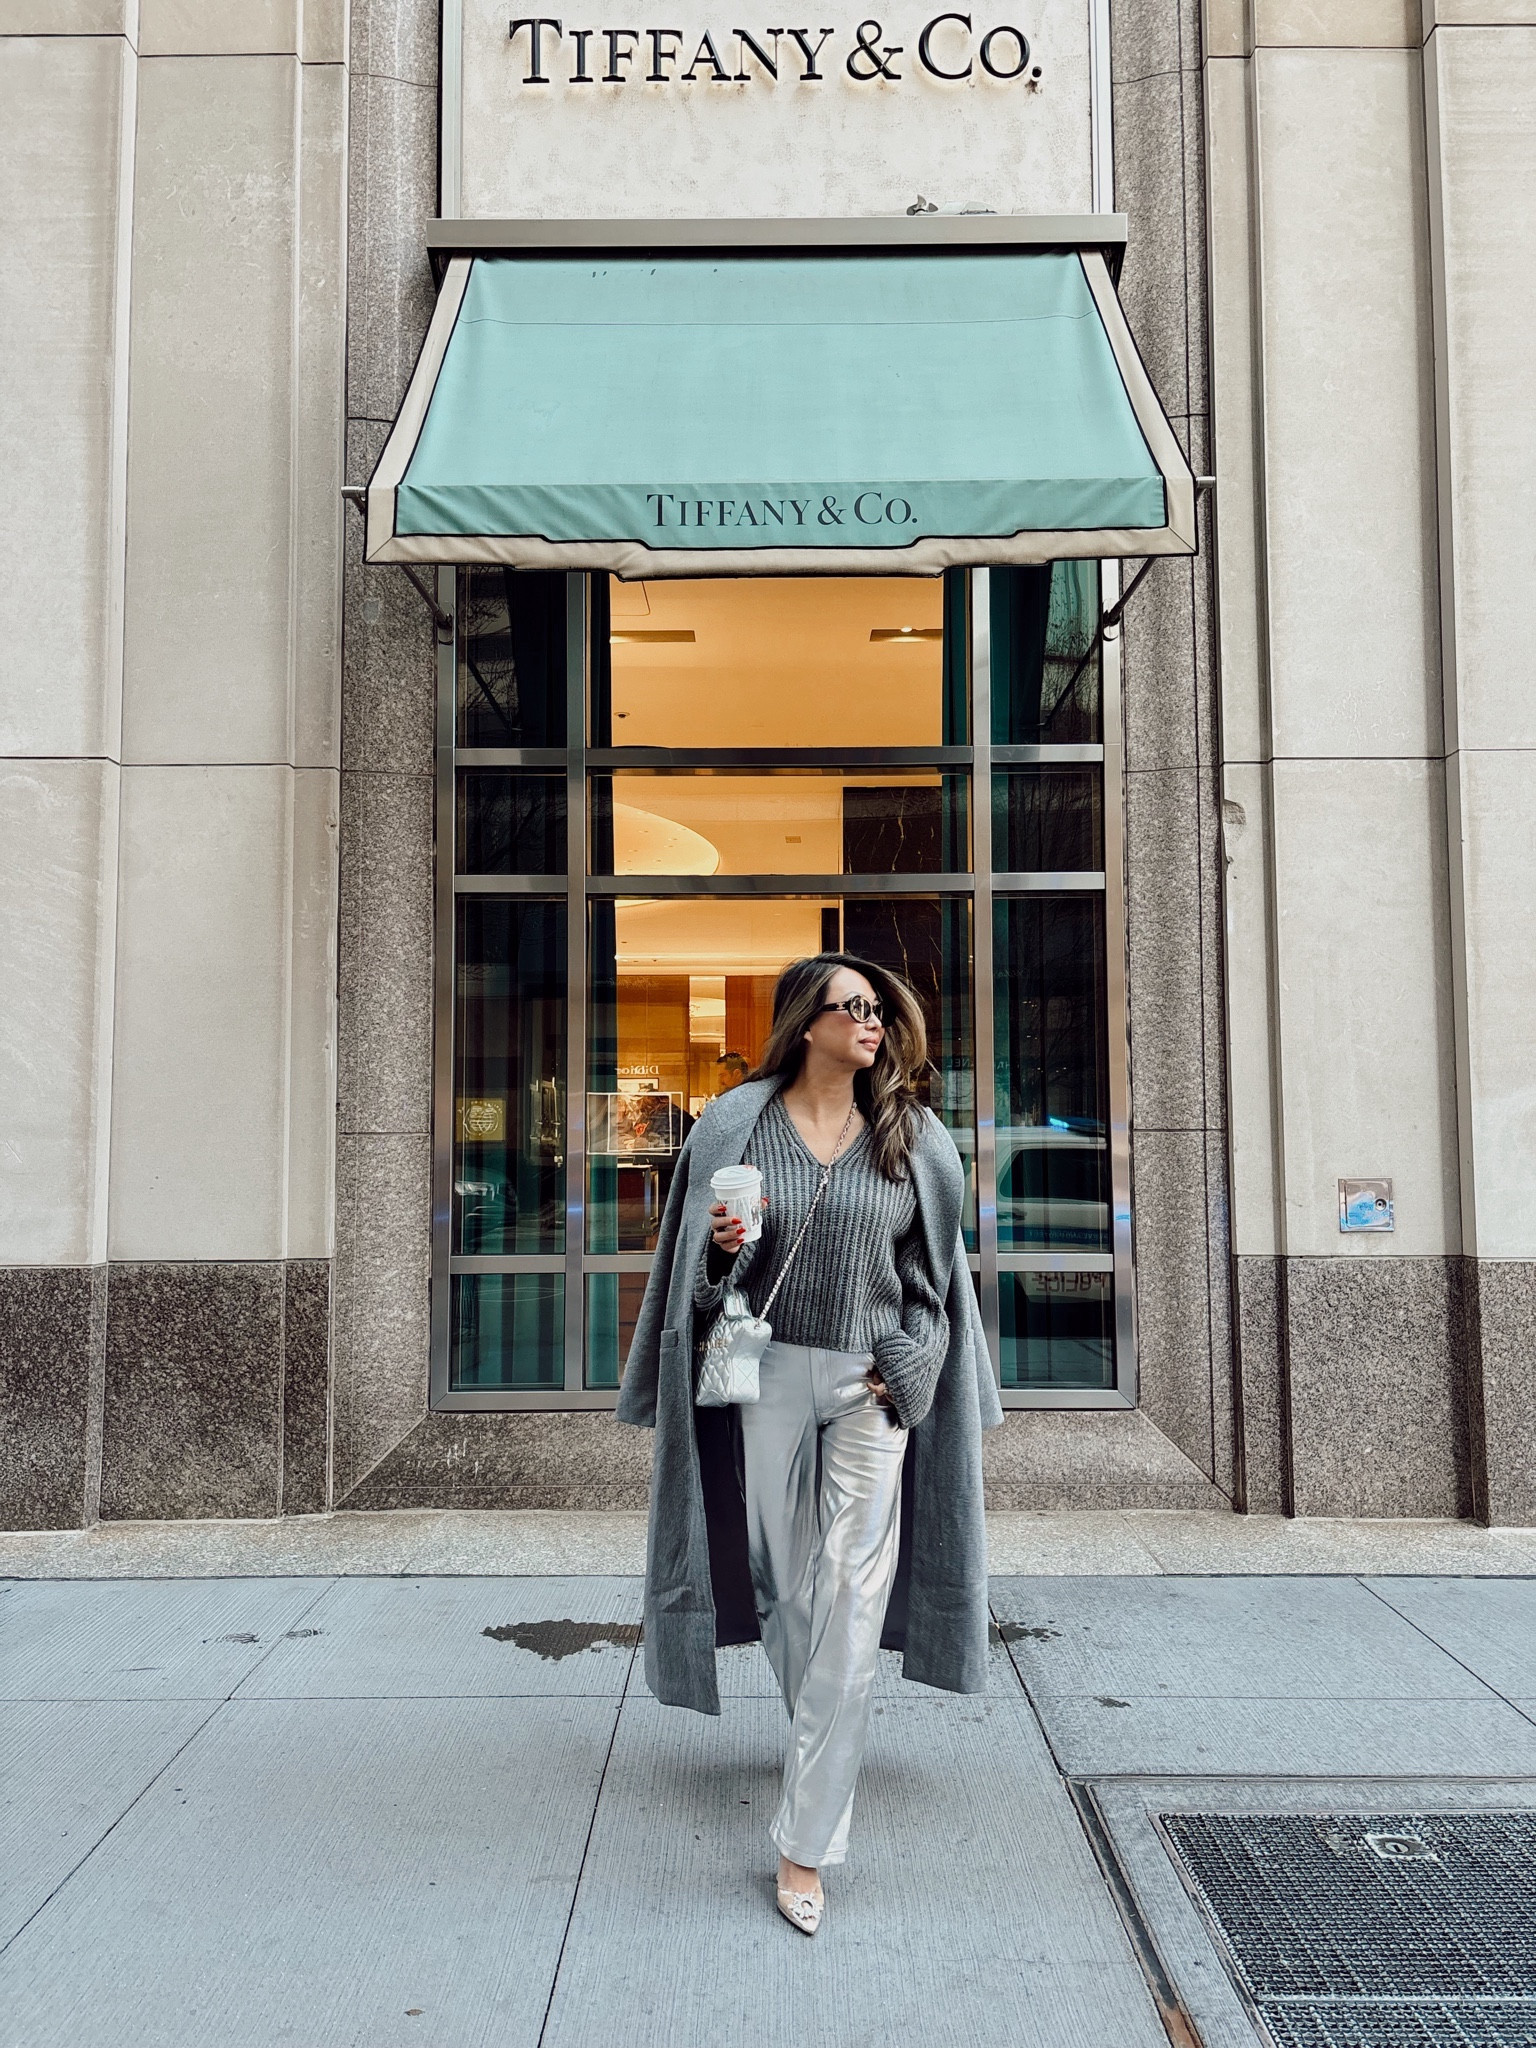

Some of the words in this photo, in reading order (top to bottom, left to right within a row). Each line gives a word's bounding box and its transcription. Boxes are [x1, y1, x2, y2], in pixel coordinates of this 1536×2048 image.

[509, 18, 835, 84] TIFFANY
[846, 19, 904, 81] &
[646, 493, 811, 527] TIFFANY
[817, 495, 847, 526] &
